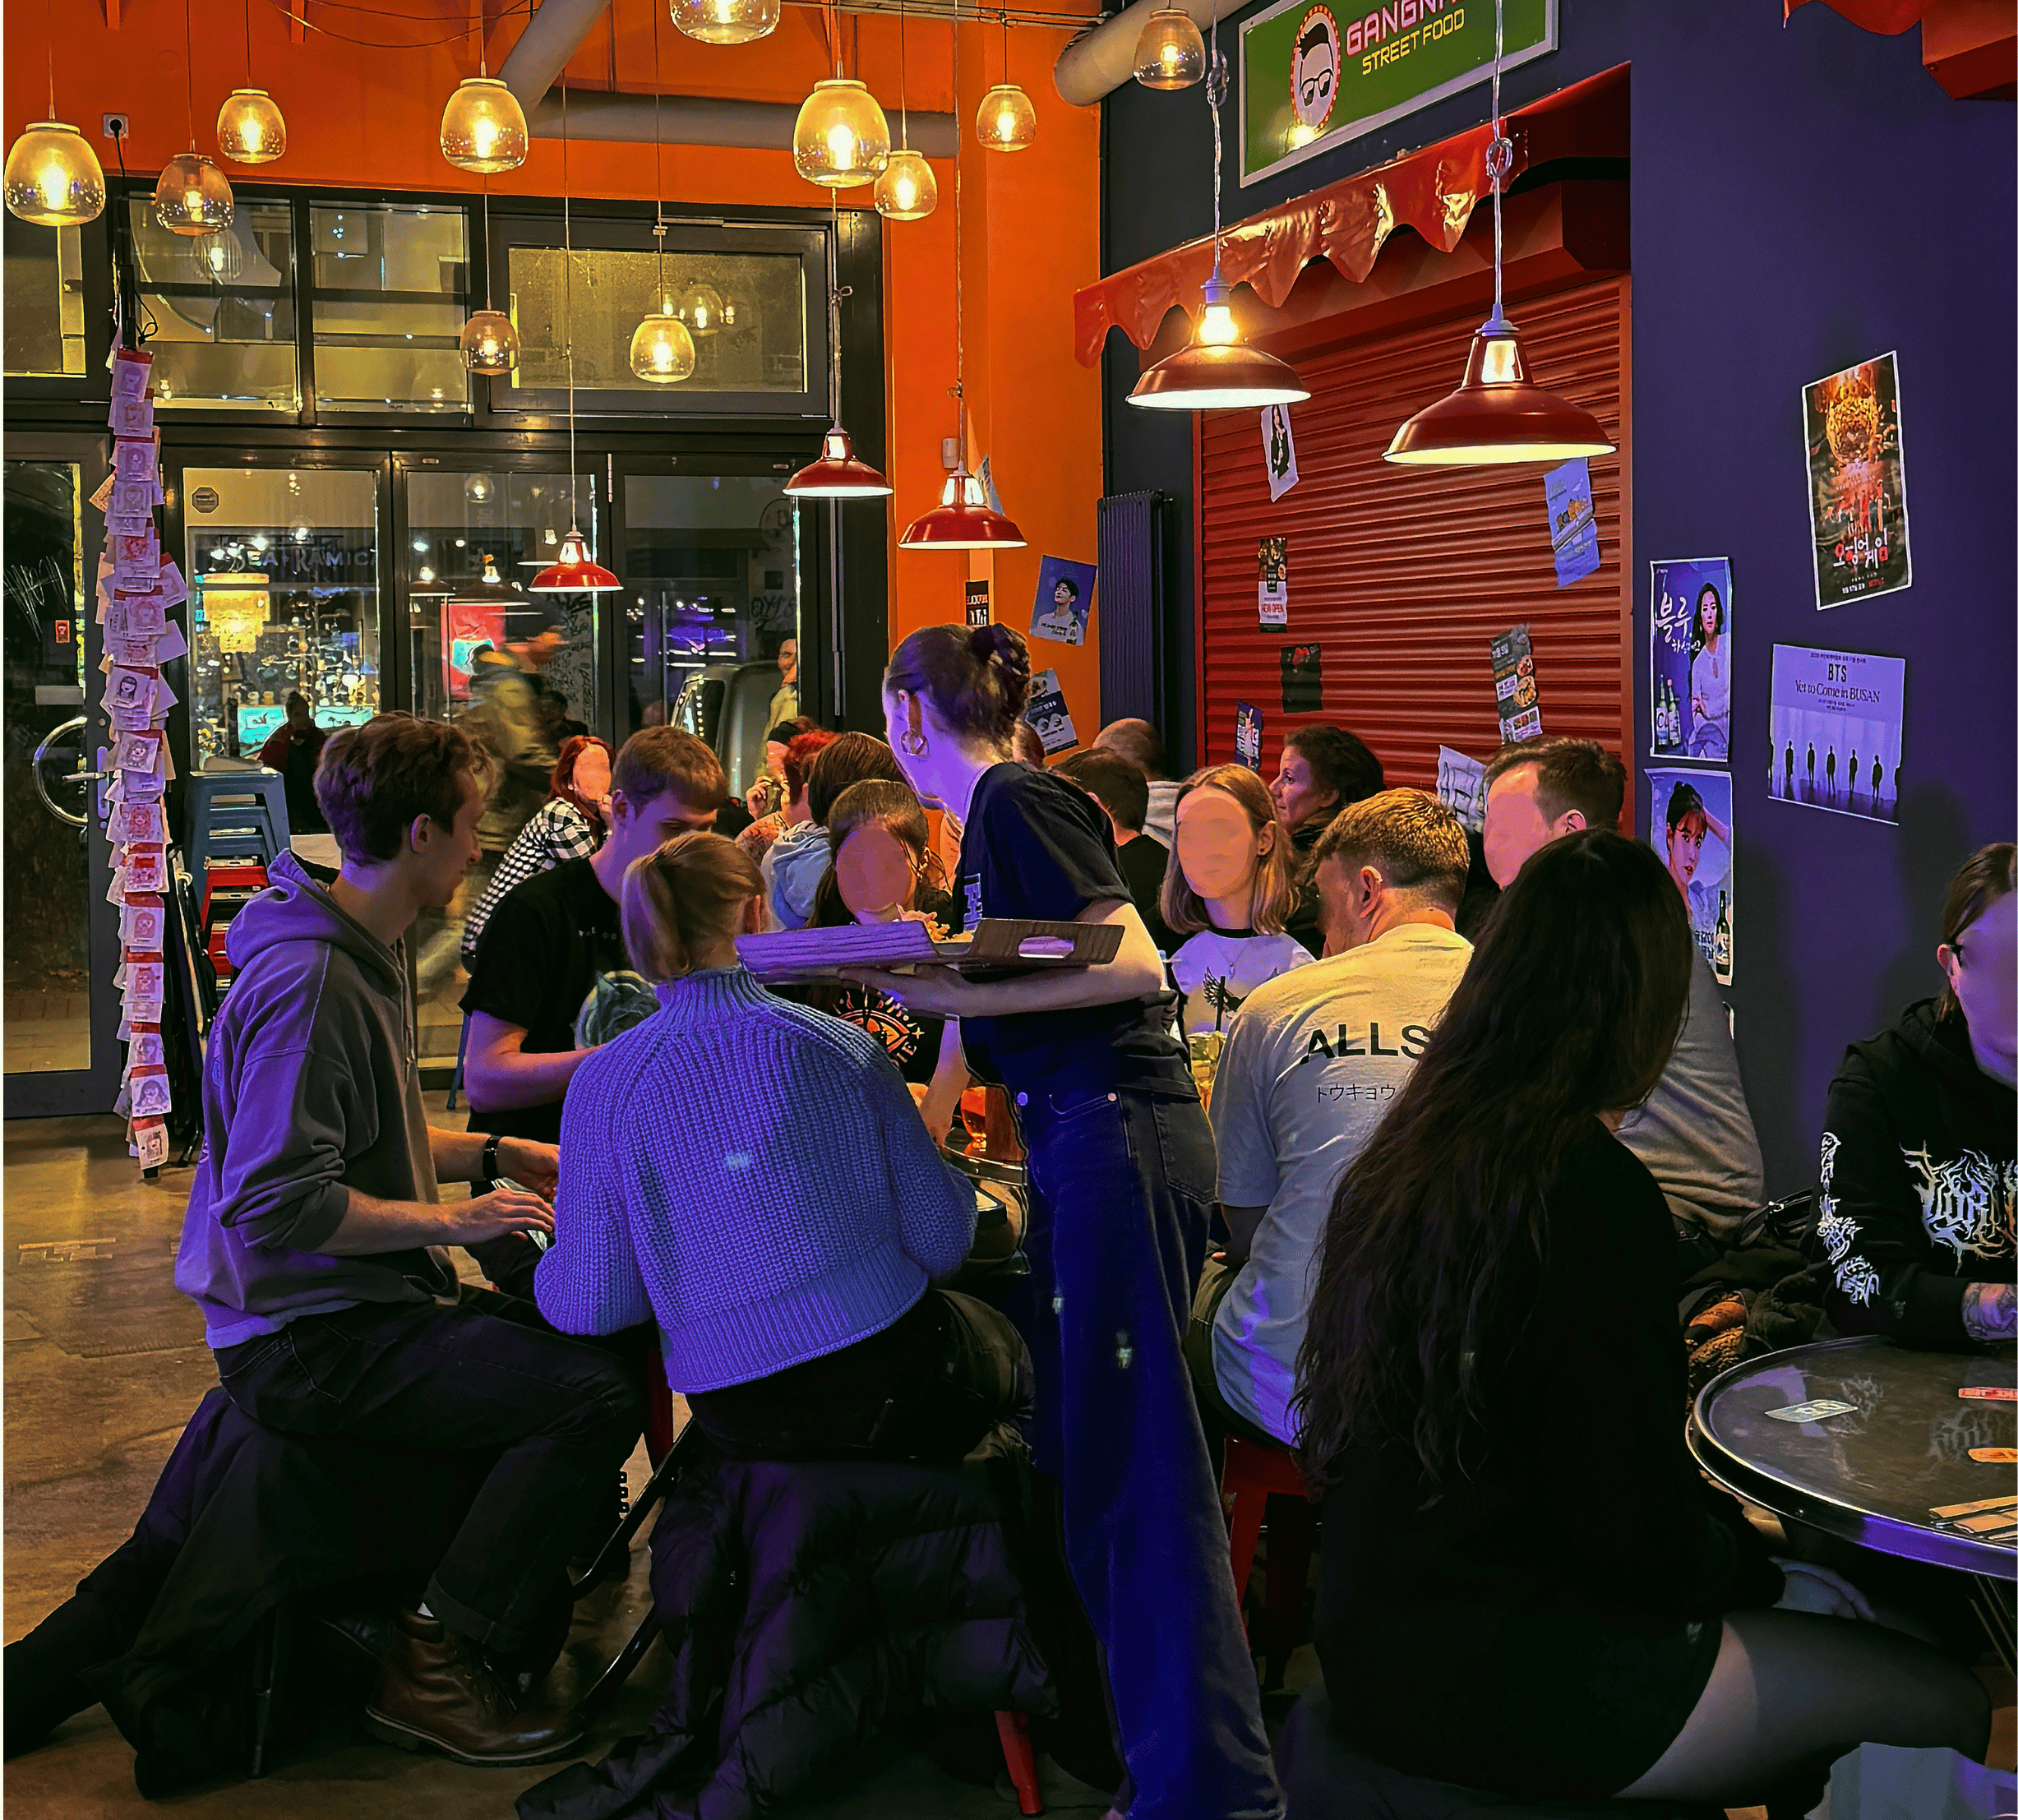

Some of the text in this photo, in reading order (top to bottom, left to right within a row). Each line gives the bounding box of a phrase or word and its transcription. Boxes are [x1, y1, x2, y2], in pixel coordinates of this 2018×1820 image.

[1362, 8, 1465, 76] STREET FOOD
[1828, 663, 1847, 683] BTS
[1795, 679, 1807, 694] Yet
[1808, 683, 1816, 695] to
[1816, 682, 1840, 699] Come
[1840, 686, 1849, 700] in
[1849, 687, 1881, 704] BUSAN
[1318, 1083, 1397, 1104] トウキョウ
